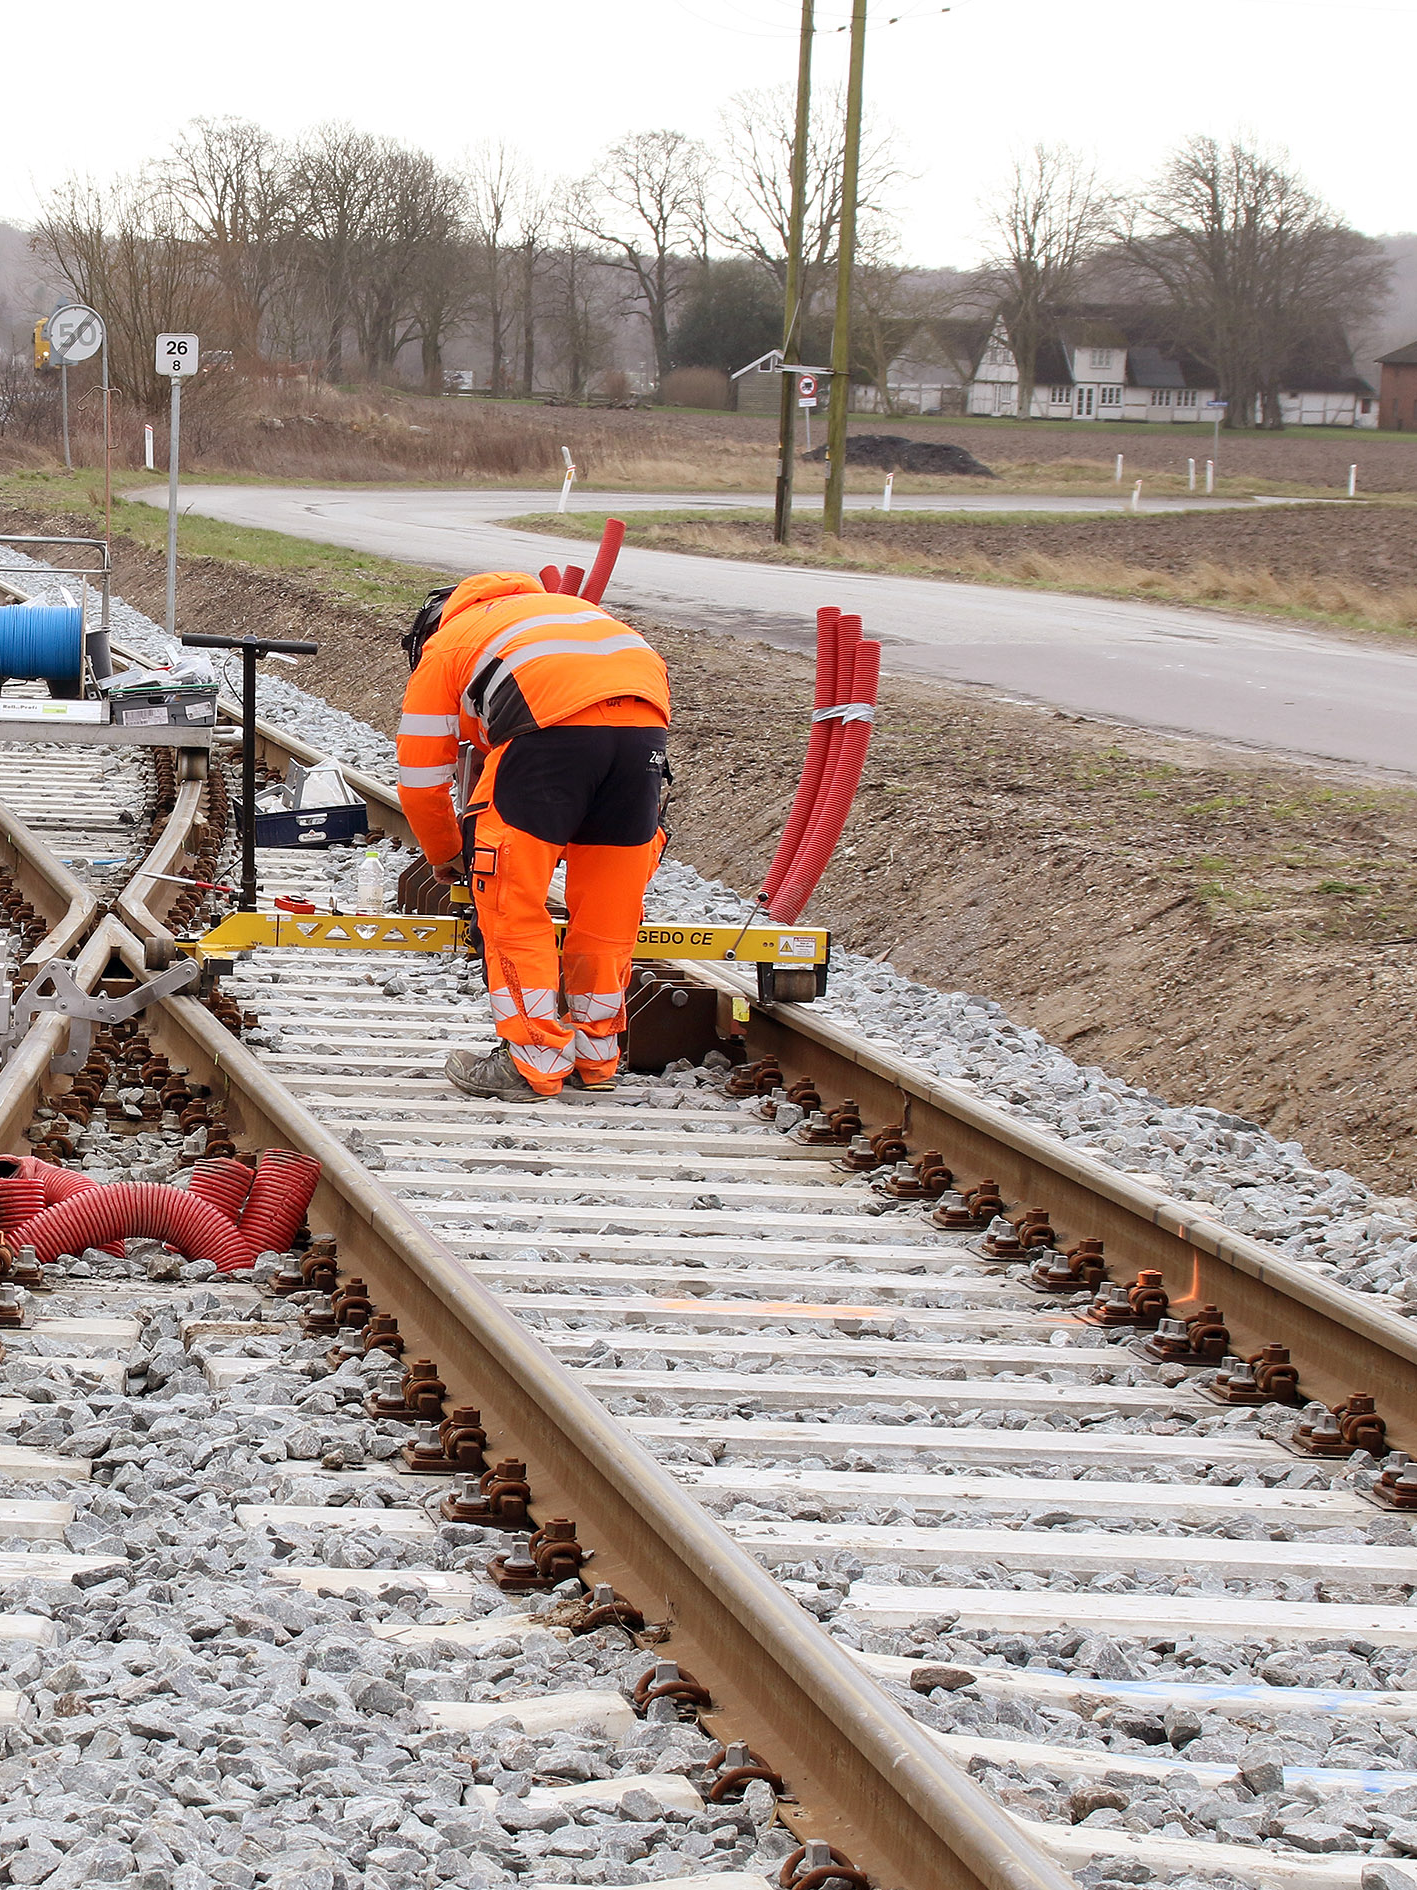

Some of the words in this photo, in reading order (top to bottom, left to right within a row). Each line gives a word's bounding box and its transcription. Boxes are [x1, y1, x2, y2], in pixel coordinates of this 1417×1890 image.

[59, 322, 97, 347] 50
[166, 340, 188, 355] 26
[172, 360, 181, 371] 8
[637, 931, 684, 943] GEDO
[691, 932, 713, 945] CE
